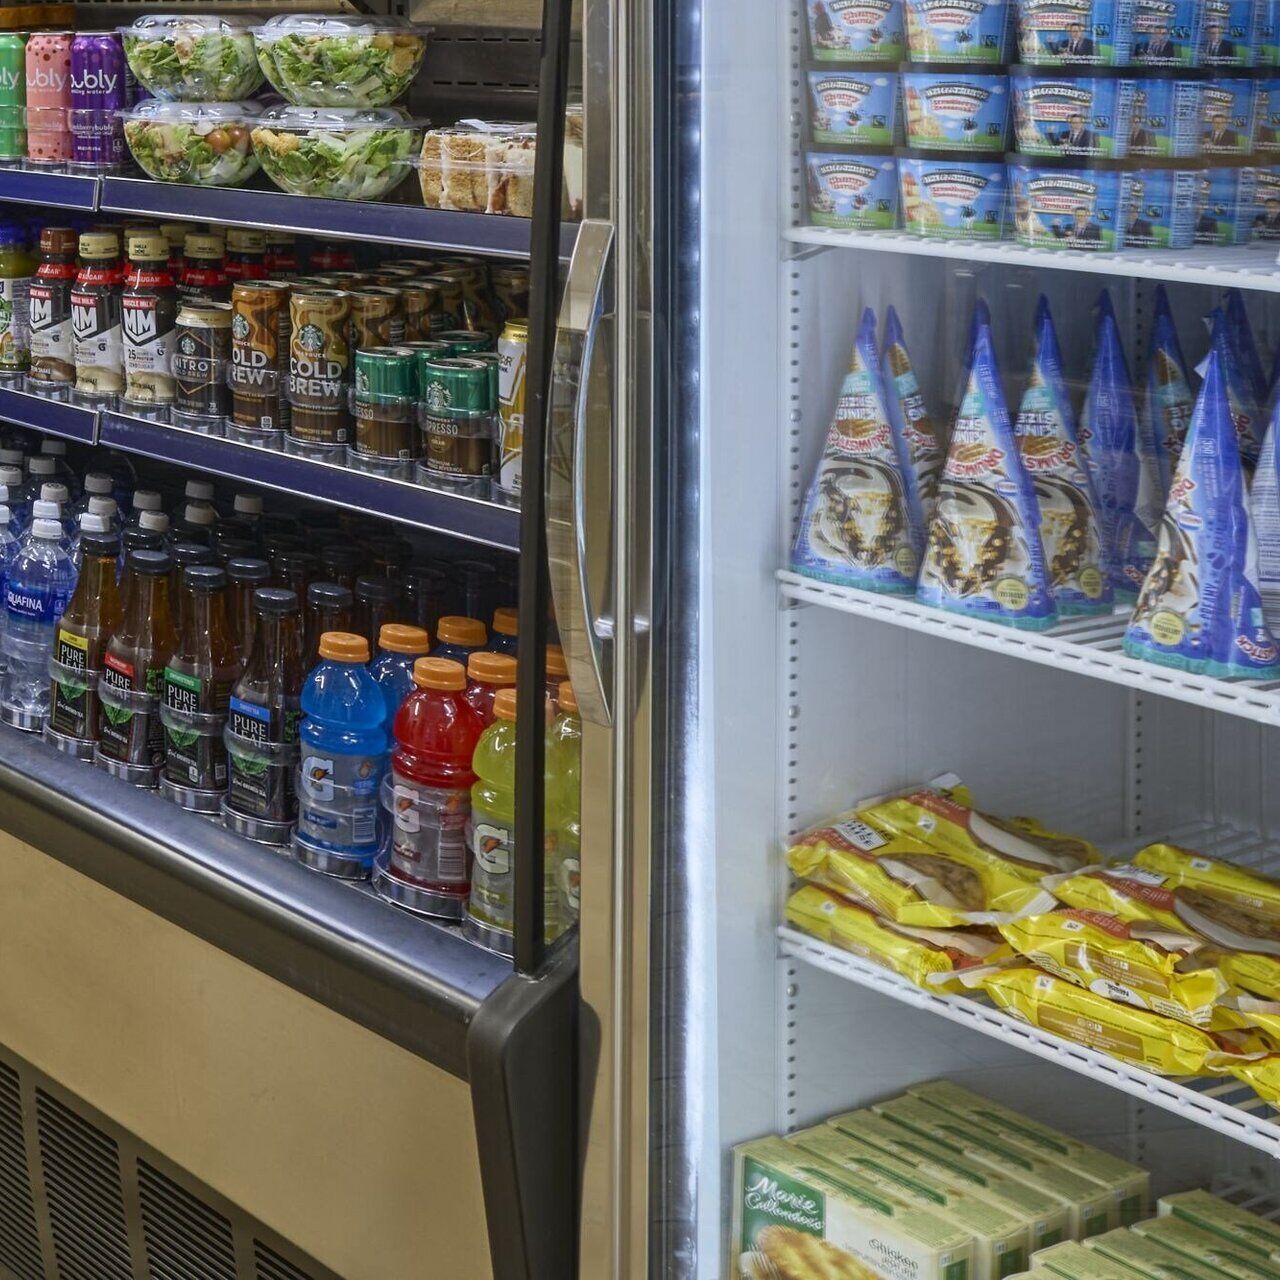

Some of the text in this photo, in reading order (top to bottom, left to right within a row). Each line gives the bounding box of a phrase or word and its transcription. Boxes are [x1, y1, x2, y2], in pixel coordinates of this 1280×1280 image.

[289, 357, 342, 379] COLD
[289, 375, 340, 397] BREW
[61, 644, 85, 663] PURE
[105, 668, 131, 689] PURE
[168, 684, 197, 706] PURE
[234, 714, 267, 737] PURE
[745, 1176, 819, 1215] Marie
[869, 1238, 919, 1271] Chicken
